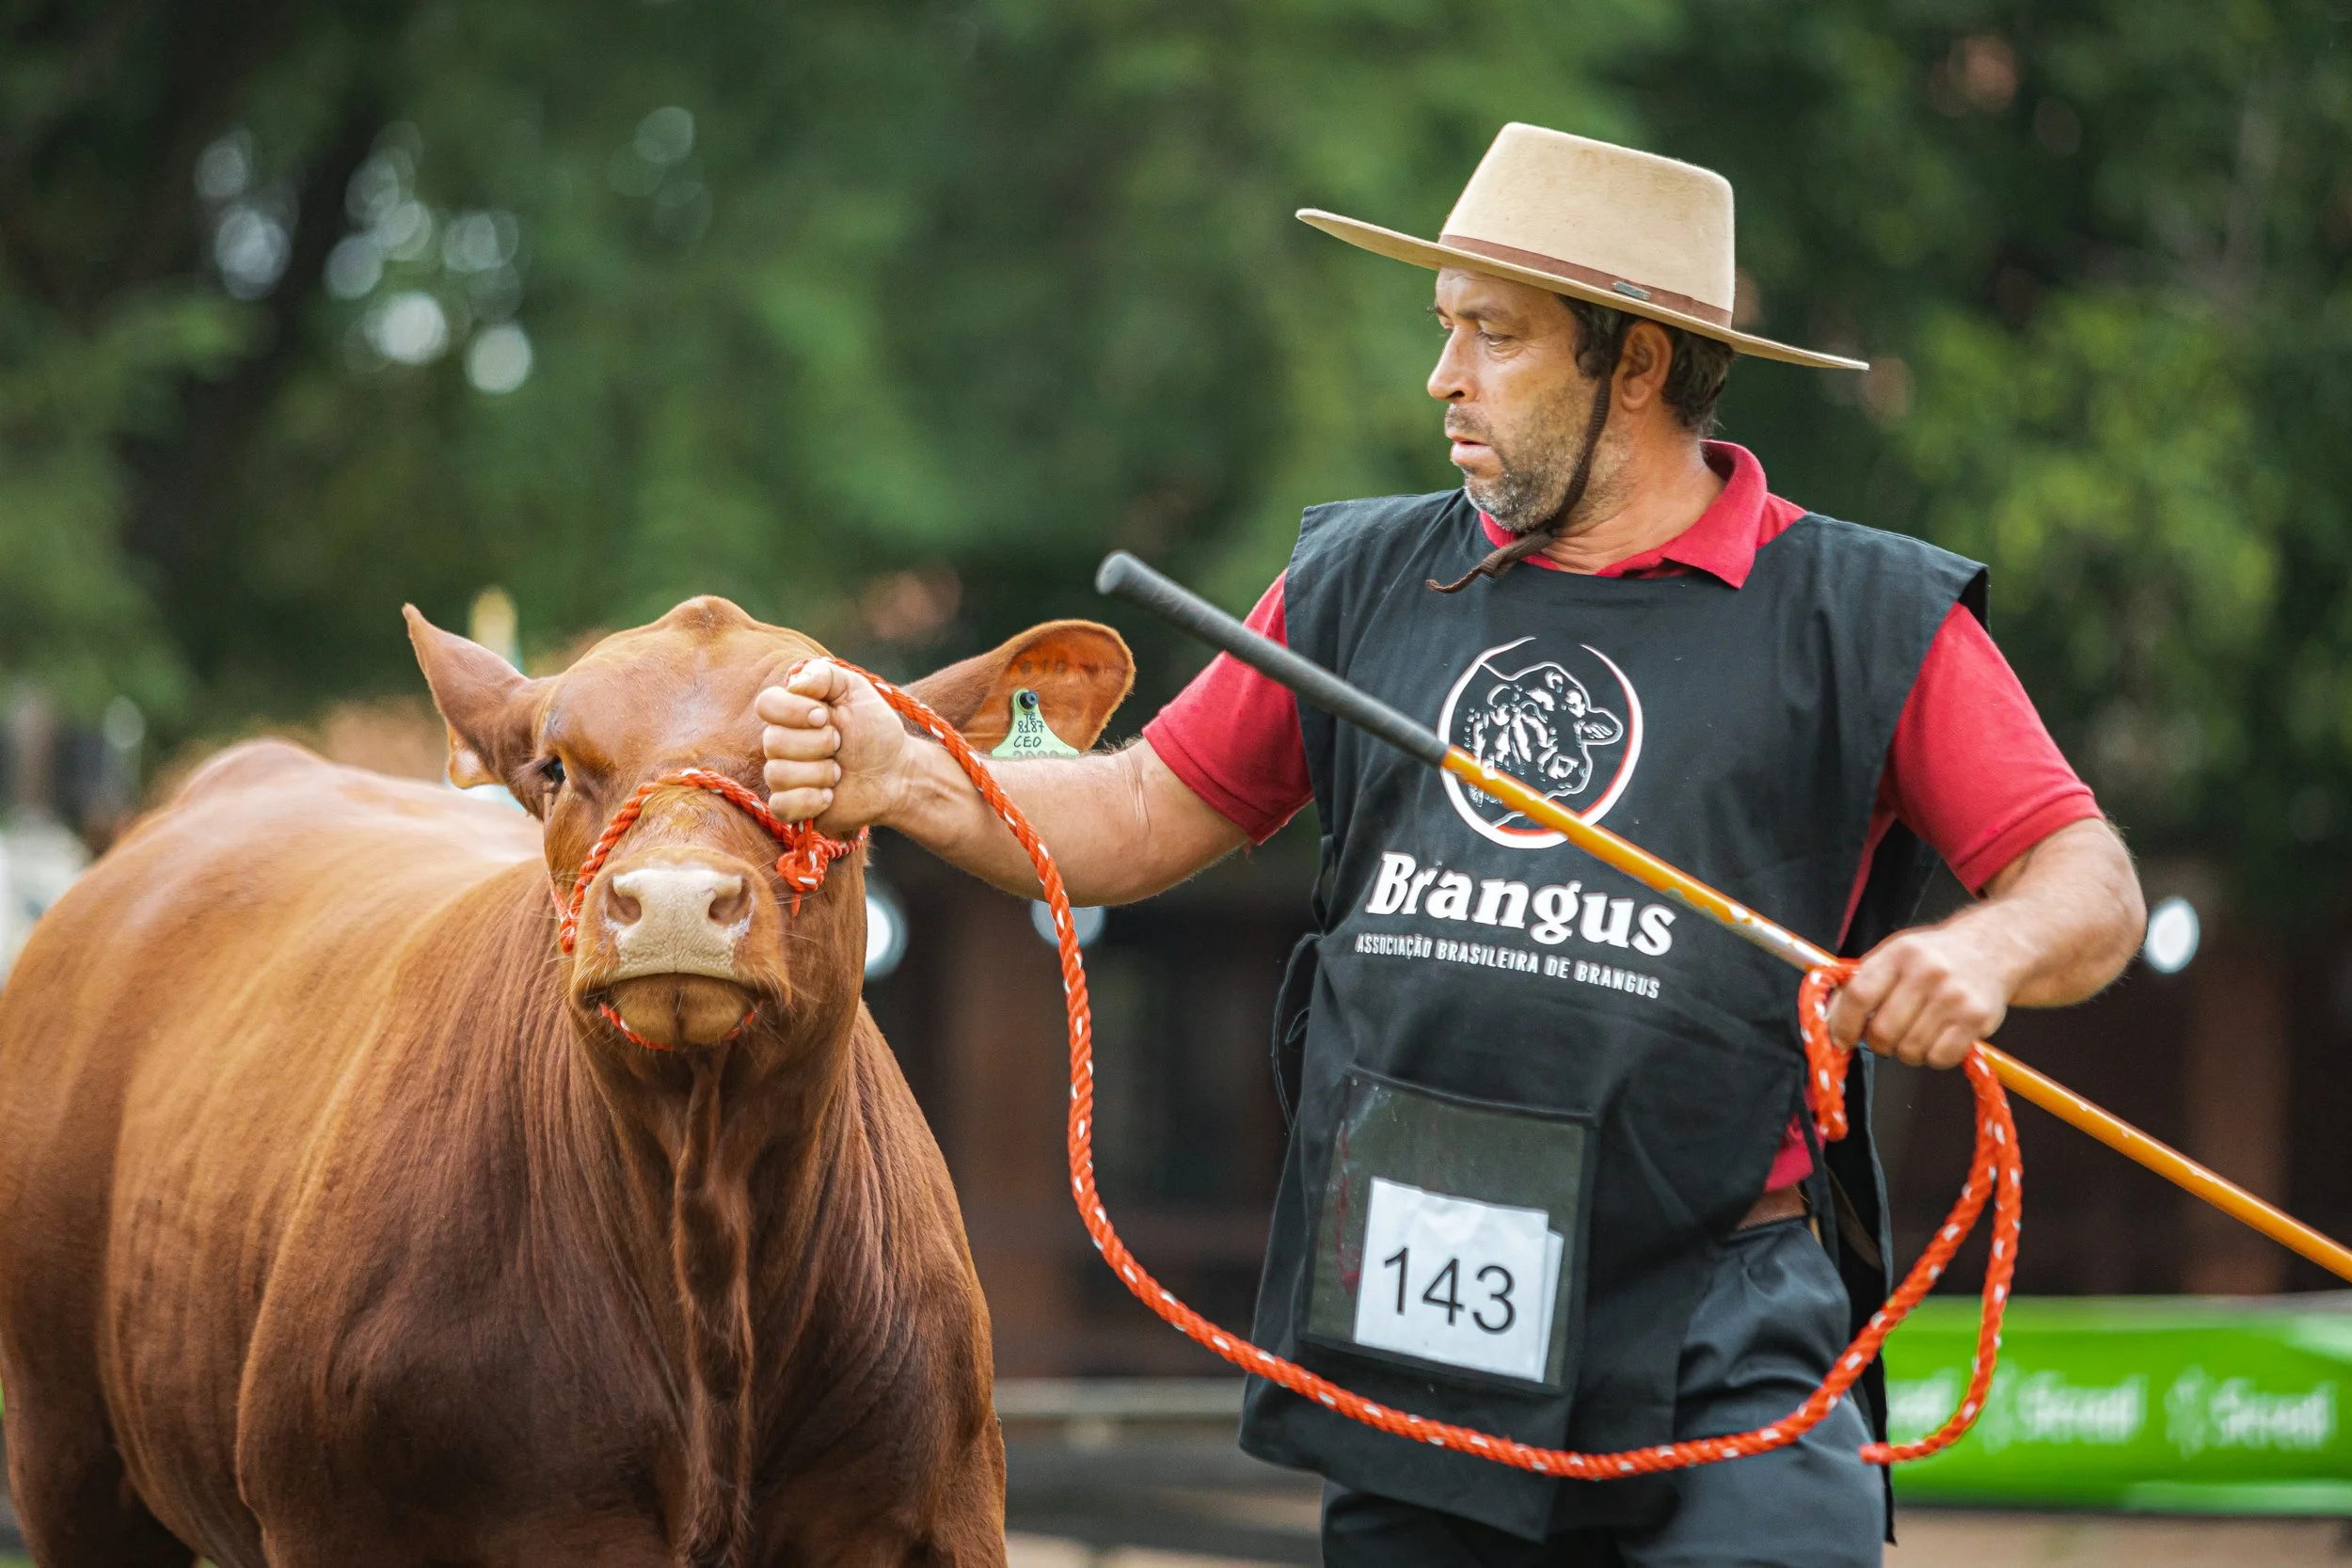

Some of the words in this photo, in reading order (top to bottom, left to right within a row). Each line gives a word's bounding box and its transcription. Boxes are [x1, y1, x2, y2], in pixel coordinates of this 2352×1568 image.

[1013, 735, 1041, 748] CEO
[1018, 721, 1044, 734] 8187
[1365, 851, 1677, 957] Brangus
[1355, 932, 1432, 960] ASSOCIAÇÃO
[1435, 938, 1539, 974] BRASILEIRA
[1544, 954, 1571, 979] DE
[1574, 959, 1661, 1000] BRANGUS
[1384, 1246, 1518, 1336] 143
